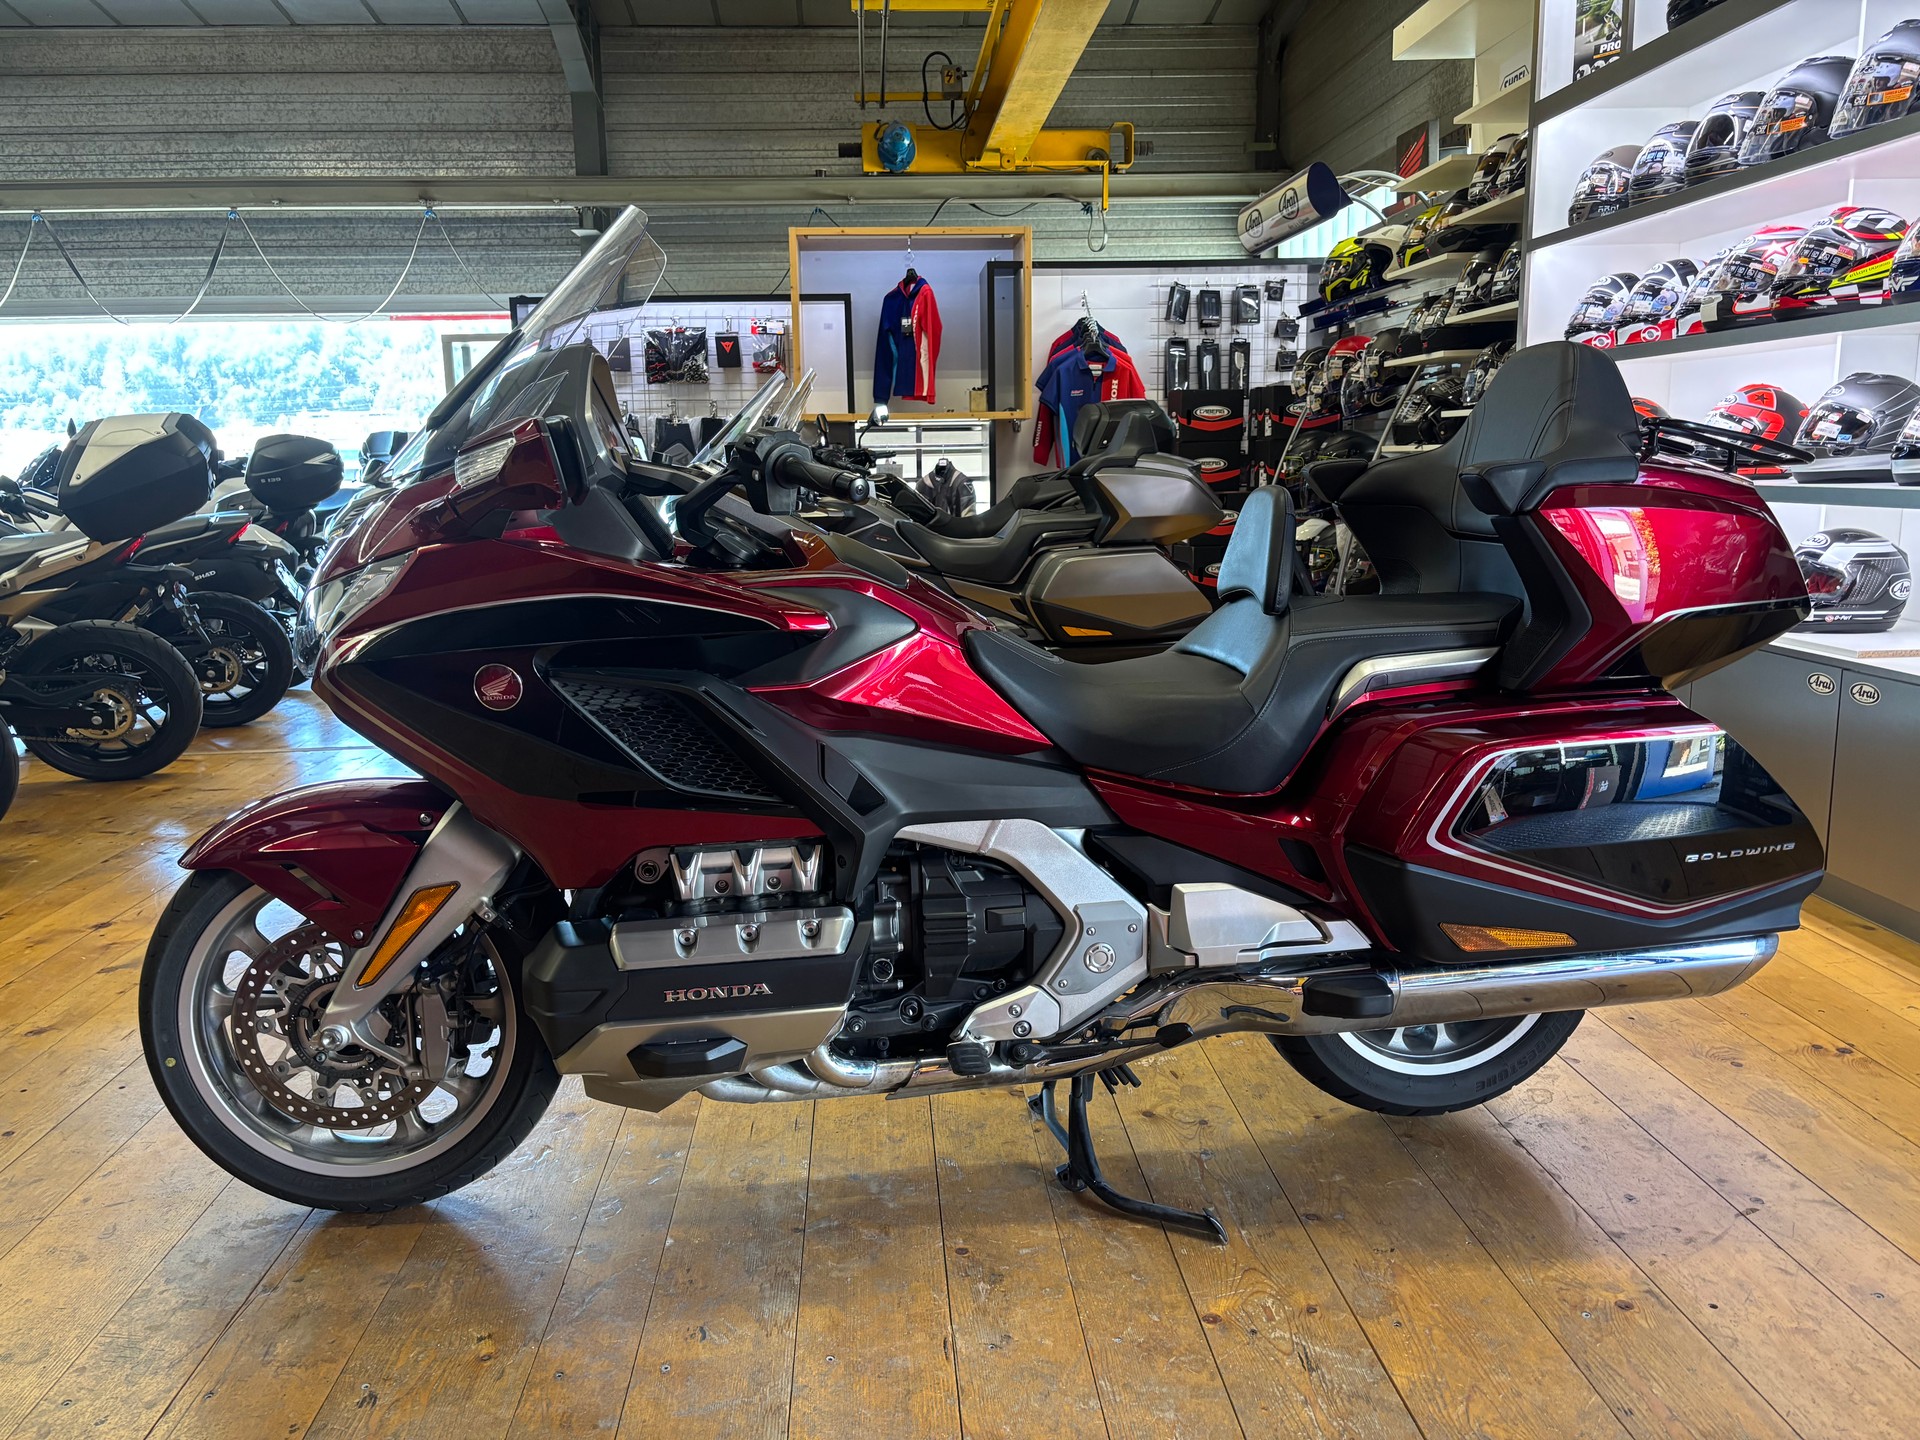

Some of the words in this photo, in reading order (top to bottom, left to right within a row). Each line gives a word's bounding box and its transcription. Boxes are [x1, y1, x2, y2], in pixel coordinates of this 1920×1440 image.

[194, 569, 216, 581] SHAD
[1810, 675, 1832, 690] Arai
[1853, 685, 1876, 700] Arai
[1684, 842, 1796, 863] GOLDWING
[663, 983, 774, 1003] HONDA
